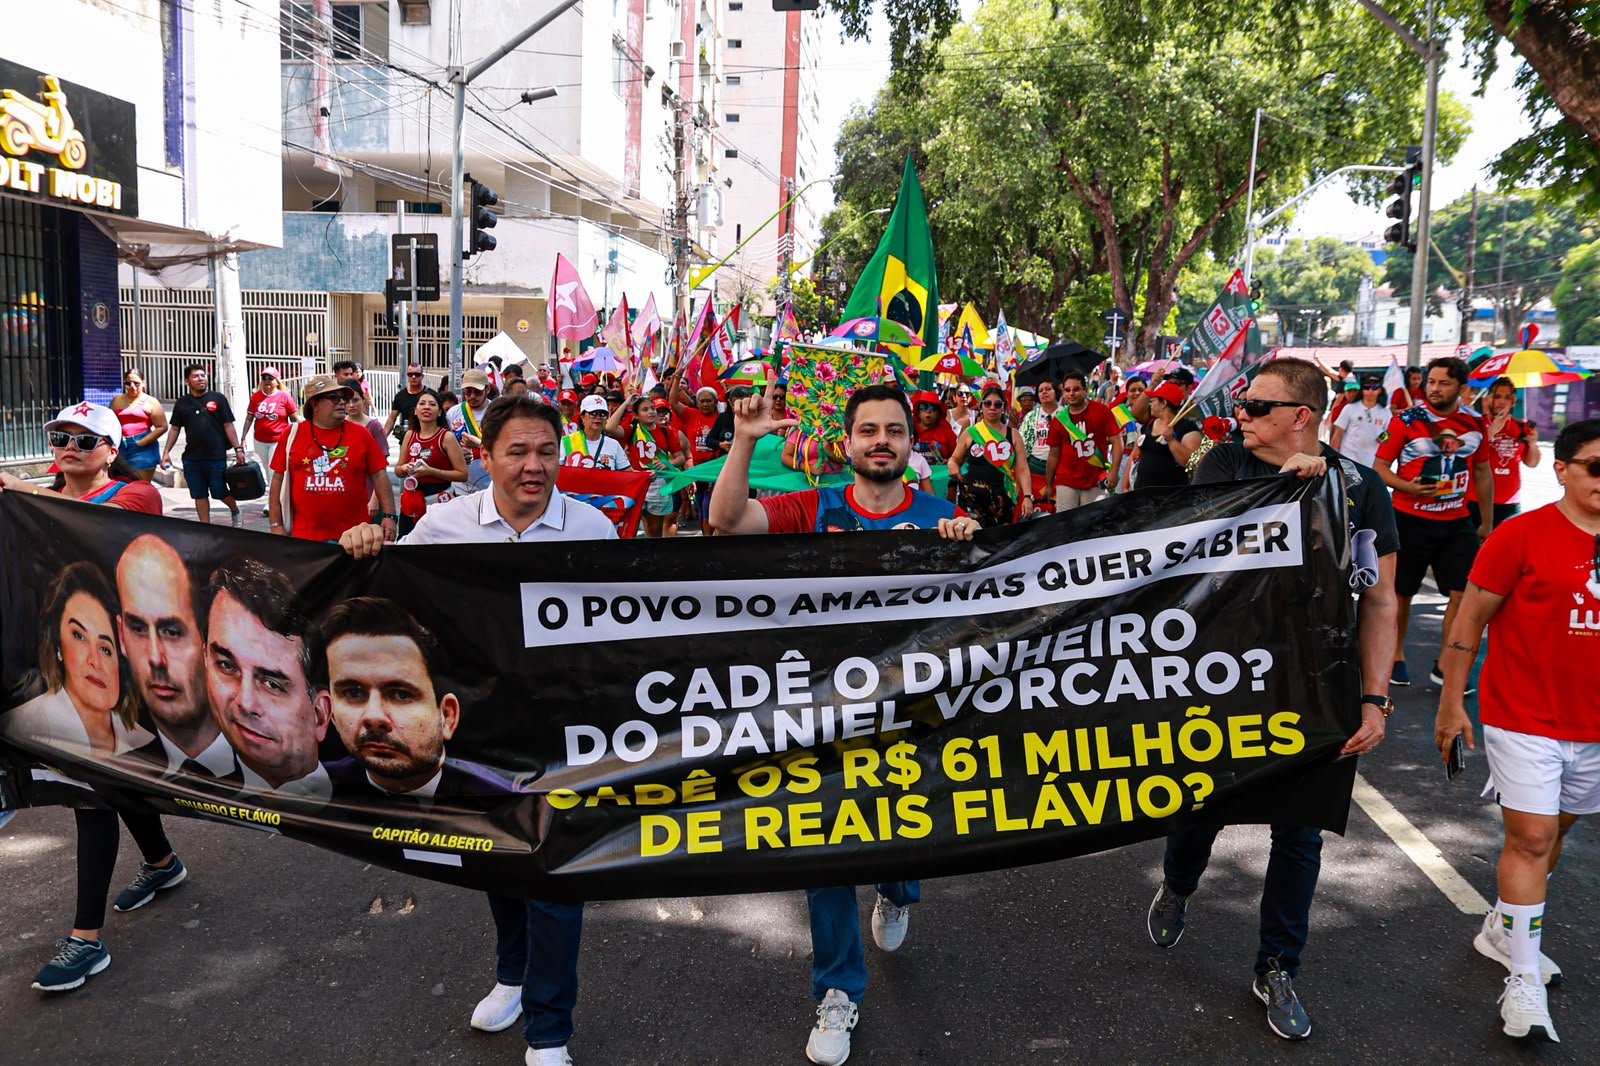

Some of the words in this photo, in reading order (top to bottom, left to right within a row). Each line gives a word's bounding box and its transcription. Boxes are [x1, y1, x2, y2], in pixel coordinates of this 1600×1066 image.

[48, 167, 121, 210] MOBI
[1210, 307, 1231, 337] 13
[948, 336, 964, 351] 13
[941, 357, 958, 369] 13
[257, 402, 276, 414] 6.7
[636, 439, 658, 459] 13
[986, 440, 1013, 462] 13
[1074, 440, 1096, 458] 13
[306, 476, 344, 488] LULA
[538, 597, 569, 630] O
[583, 595, 702, 627] POVO
[715, 594, 776, 619] DO
[788, 571, 1026, 616] AMAZONAS
[1037, 547, 1152, 592] QUER
[1163, 521, 1290, 570] SABER
[635, 649, 813, 716] CADÊ
[833, 656, 880, 700] O
[901, 608, 1197, 695] DINHEIRO
[564, 719, 659, 767] DO
[681, 700, 912, 758] DANIEL
[934, 648, 1274, 720] VORCARO?
[737, 756, 822, 799] OS
[843, 740, 922, 791] R$
[941, 735, 1003, 782] 61
[1023, 705, 1305, 776] MILHÕES
[174, 797, 229, 816] EDUARDO
[229, 807, 238, 818] E
[239, 807, 281, 826] FLÁVIO
[640, 810, 723, 858] DE
[745, 794, 933, 851] REAIS
[953, 771, 1214, 835] FLÁVIO?
[372, 826, 430, 845] CAPITÃO
[429, 832, 493, 852] ALBERTO
